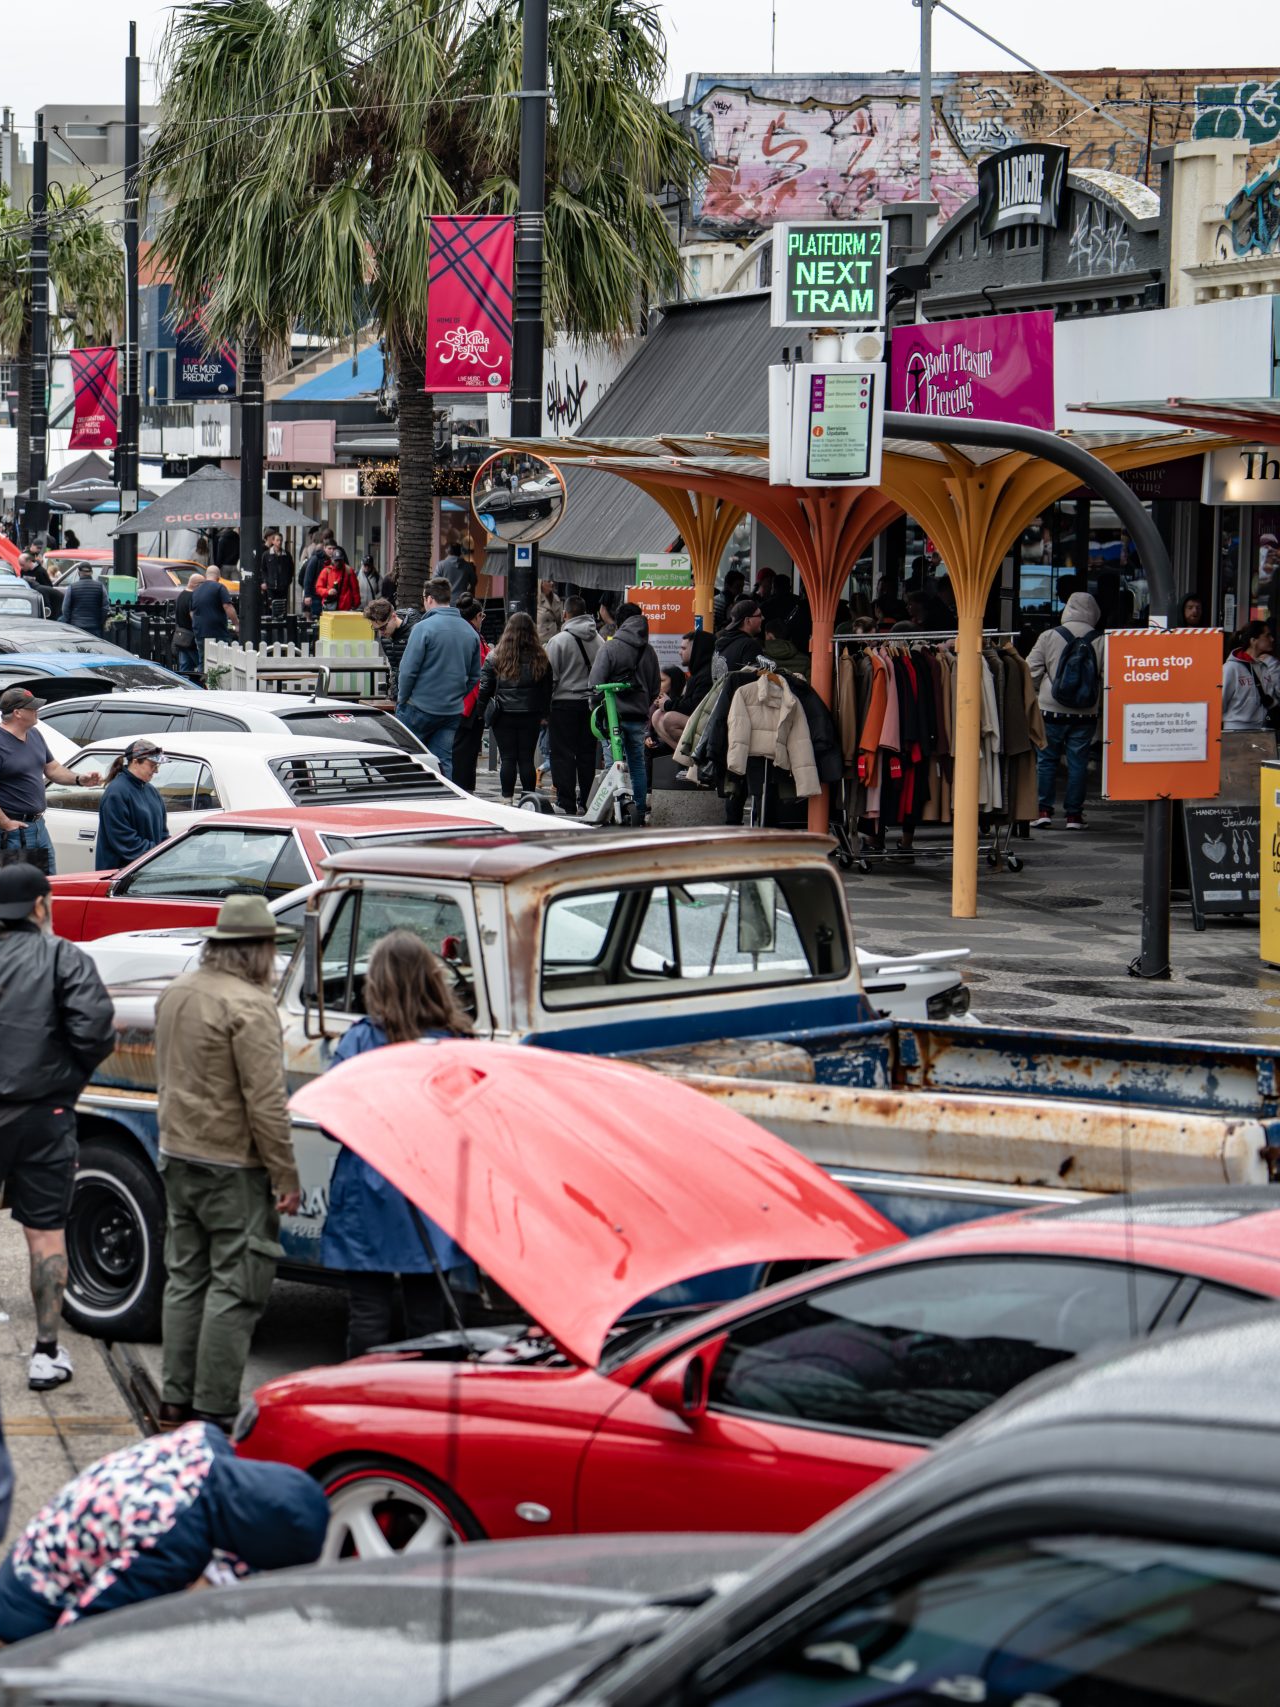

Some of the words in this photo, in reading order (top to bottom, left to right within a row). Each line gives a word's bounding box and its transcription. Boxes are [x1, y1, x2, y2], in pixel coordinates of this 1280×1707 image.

[788, 233, 866, 256] PLATFORM
[870, 232, 881, 255] 2
[796, 261, 873, 285] NEXT
[792, 289, 874, 313] TRAM
[925, 345, 951, 381] Body
[953, 343, 993, 379] Pleasure
[182, 364, 198, 373] LIVE
[200, 364, 222, 374] MUSIC
[182, 373, 216, 382] PRECINCT
[927, 378, 974, 415] Piercing
[662, 603, 680, 612] stop
[642, 611, 666, 620] losed
[1124, 655, 1159, 667] Tram
[1162, 656, 1193, 669] stop
[1124, 670, 1169, 682] closed
[1209, 872, 1224, 880] Give
[1231, 872, 1243, 882] gift
[1245, 871, 1259, 879] that
